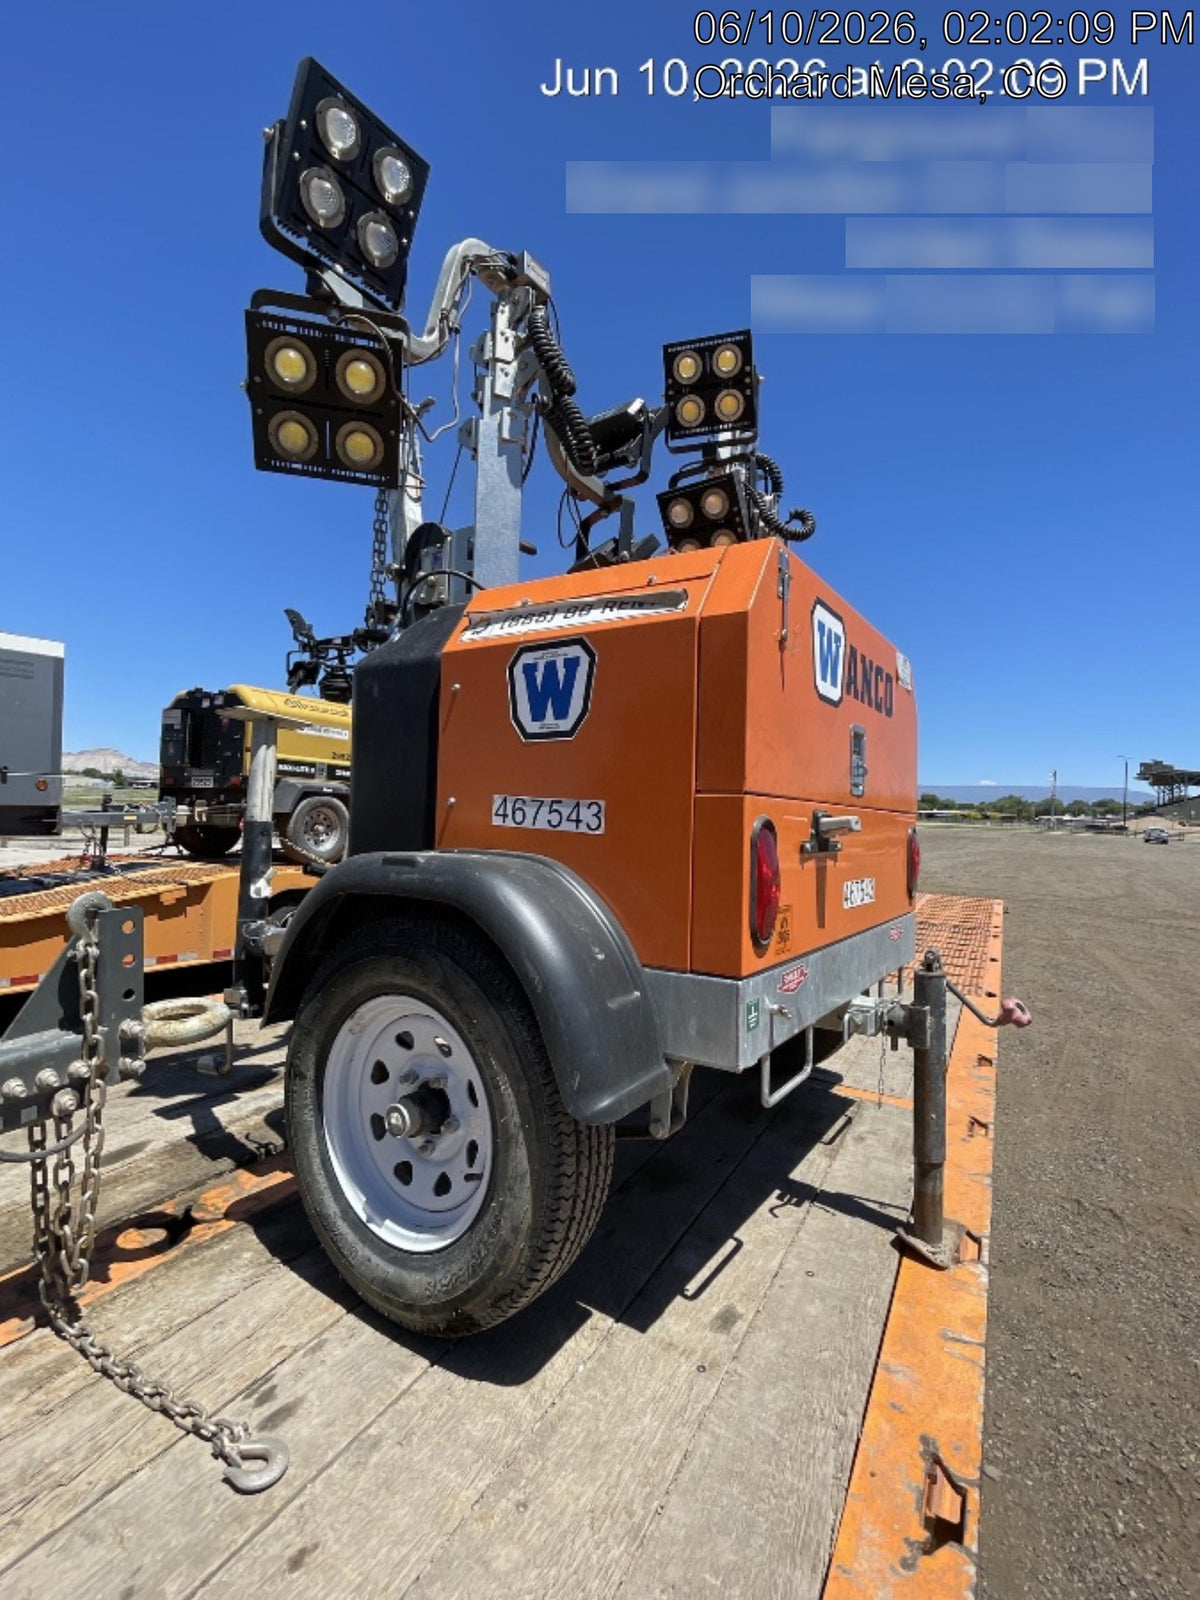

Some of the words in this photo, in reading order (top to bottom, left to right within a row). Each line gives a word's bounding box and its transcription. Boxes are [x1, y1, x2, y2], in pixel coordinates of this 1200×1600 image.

[522, 655, 580, 722] W
[817, 619, 894, 718] WANCO
[494, 796, 602, 831] 467543
